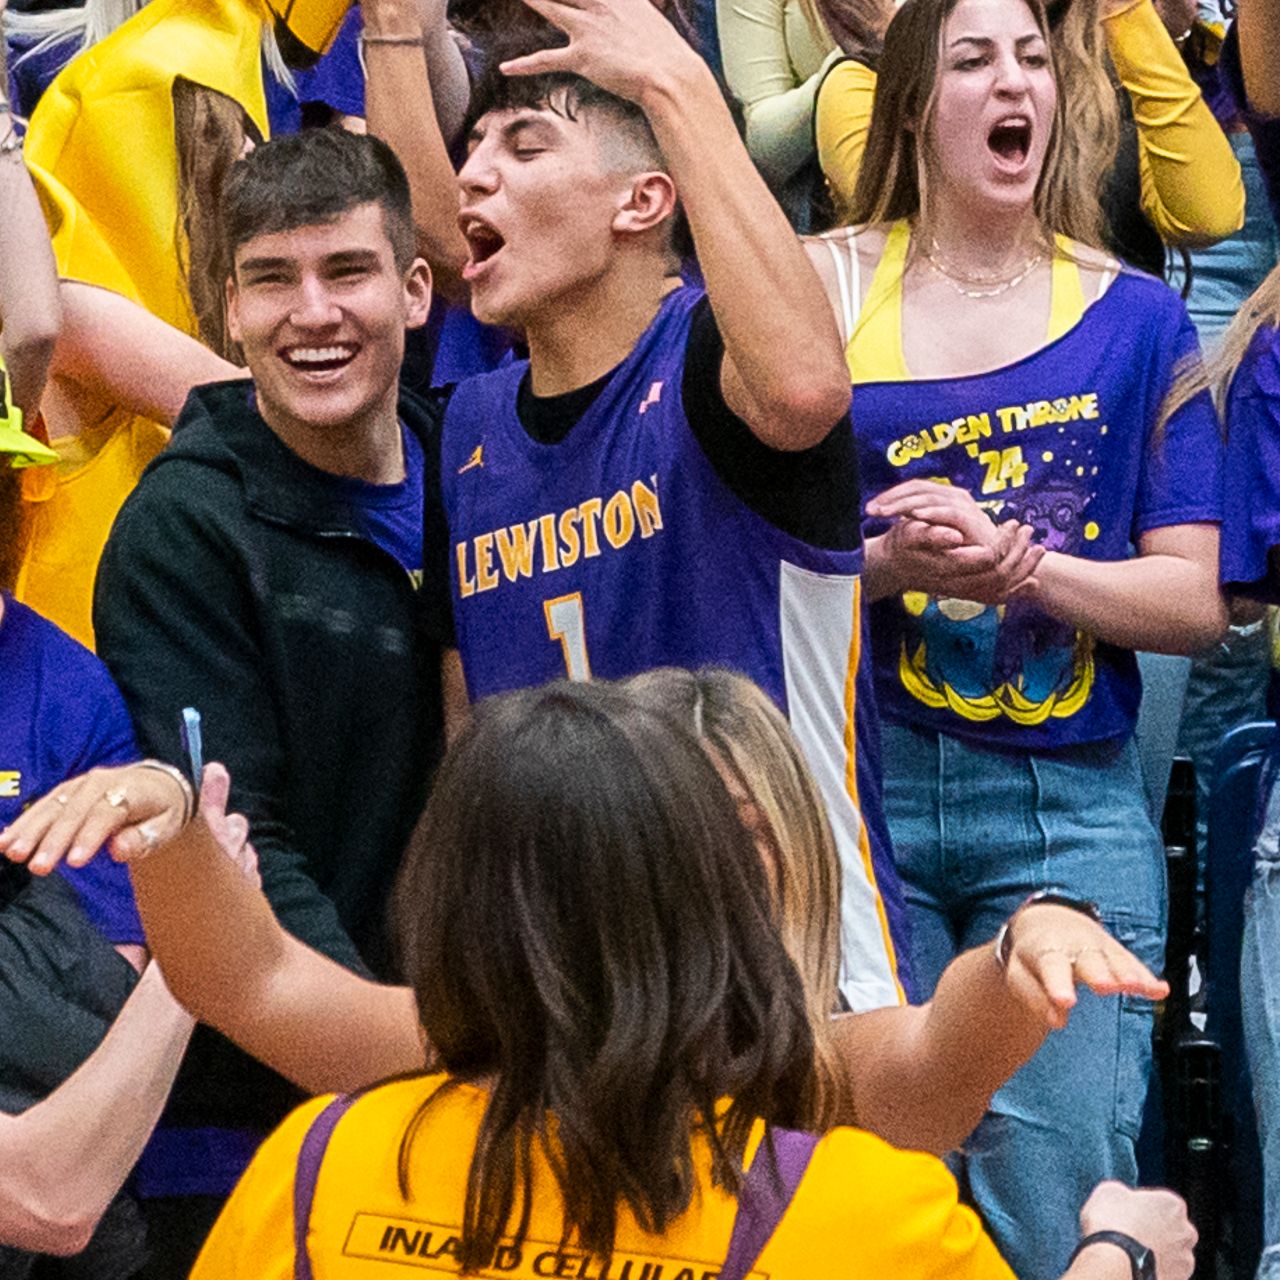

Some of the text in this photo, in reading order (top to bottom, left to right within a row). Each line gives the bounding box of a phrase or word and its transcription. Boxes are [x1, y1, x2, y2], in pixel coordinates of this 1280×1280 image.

[886, 392, 1099, 467] GOLDEN THRONE
[455, 472, 664, 599] LEWISTON
[543, 591, 591, 684] 1
[379, 1226, 721, 1280] INLAD CELLULA
